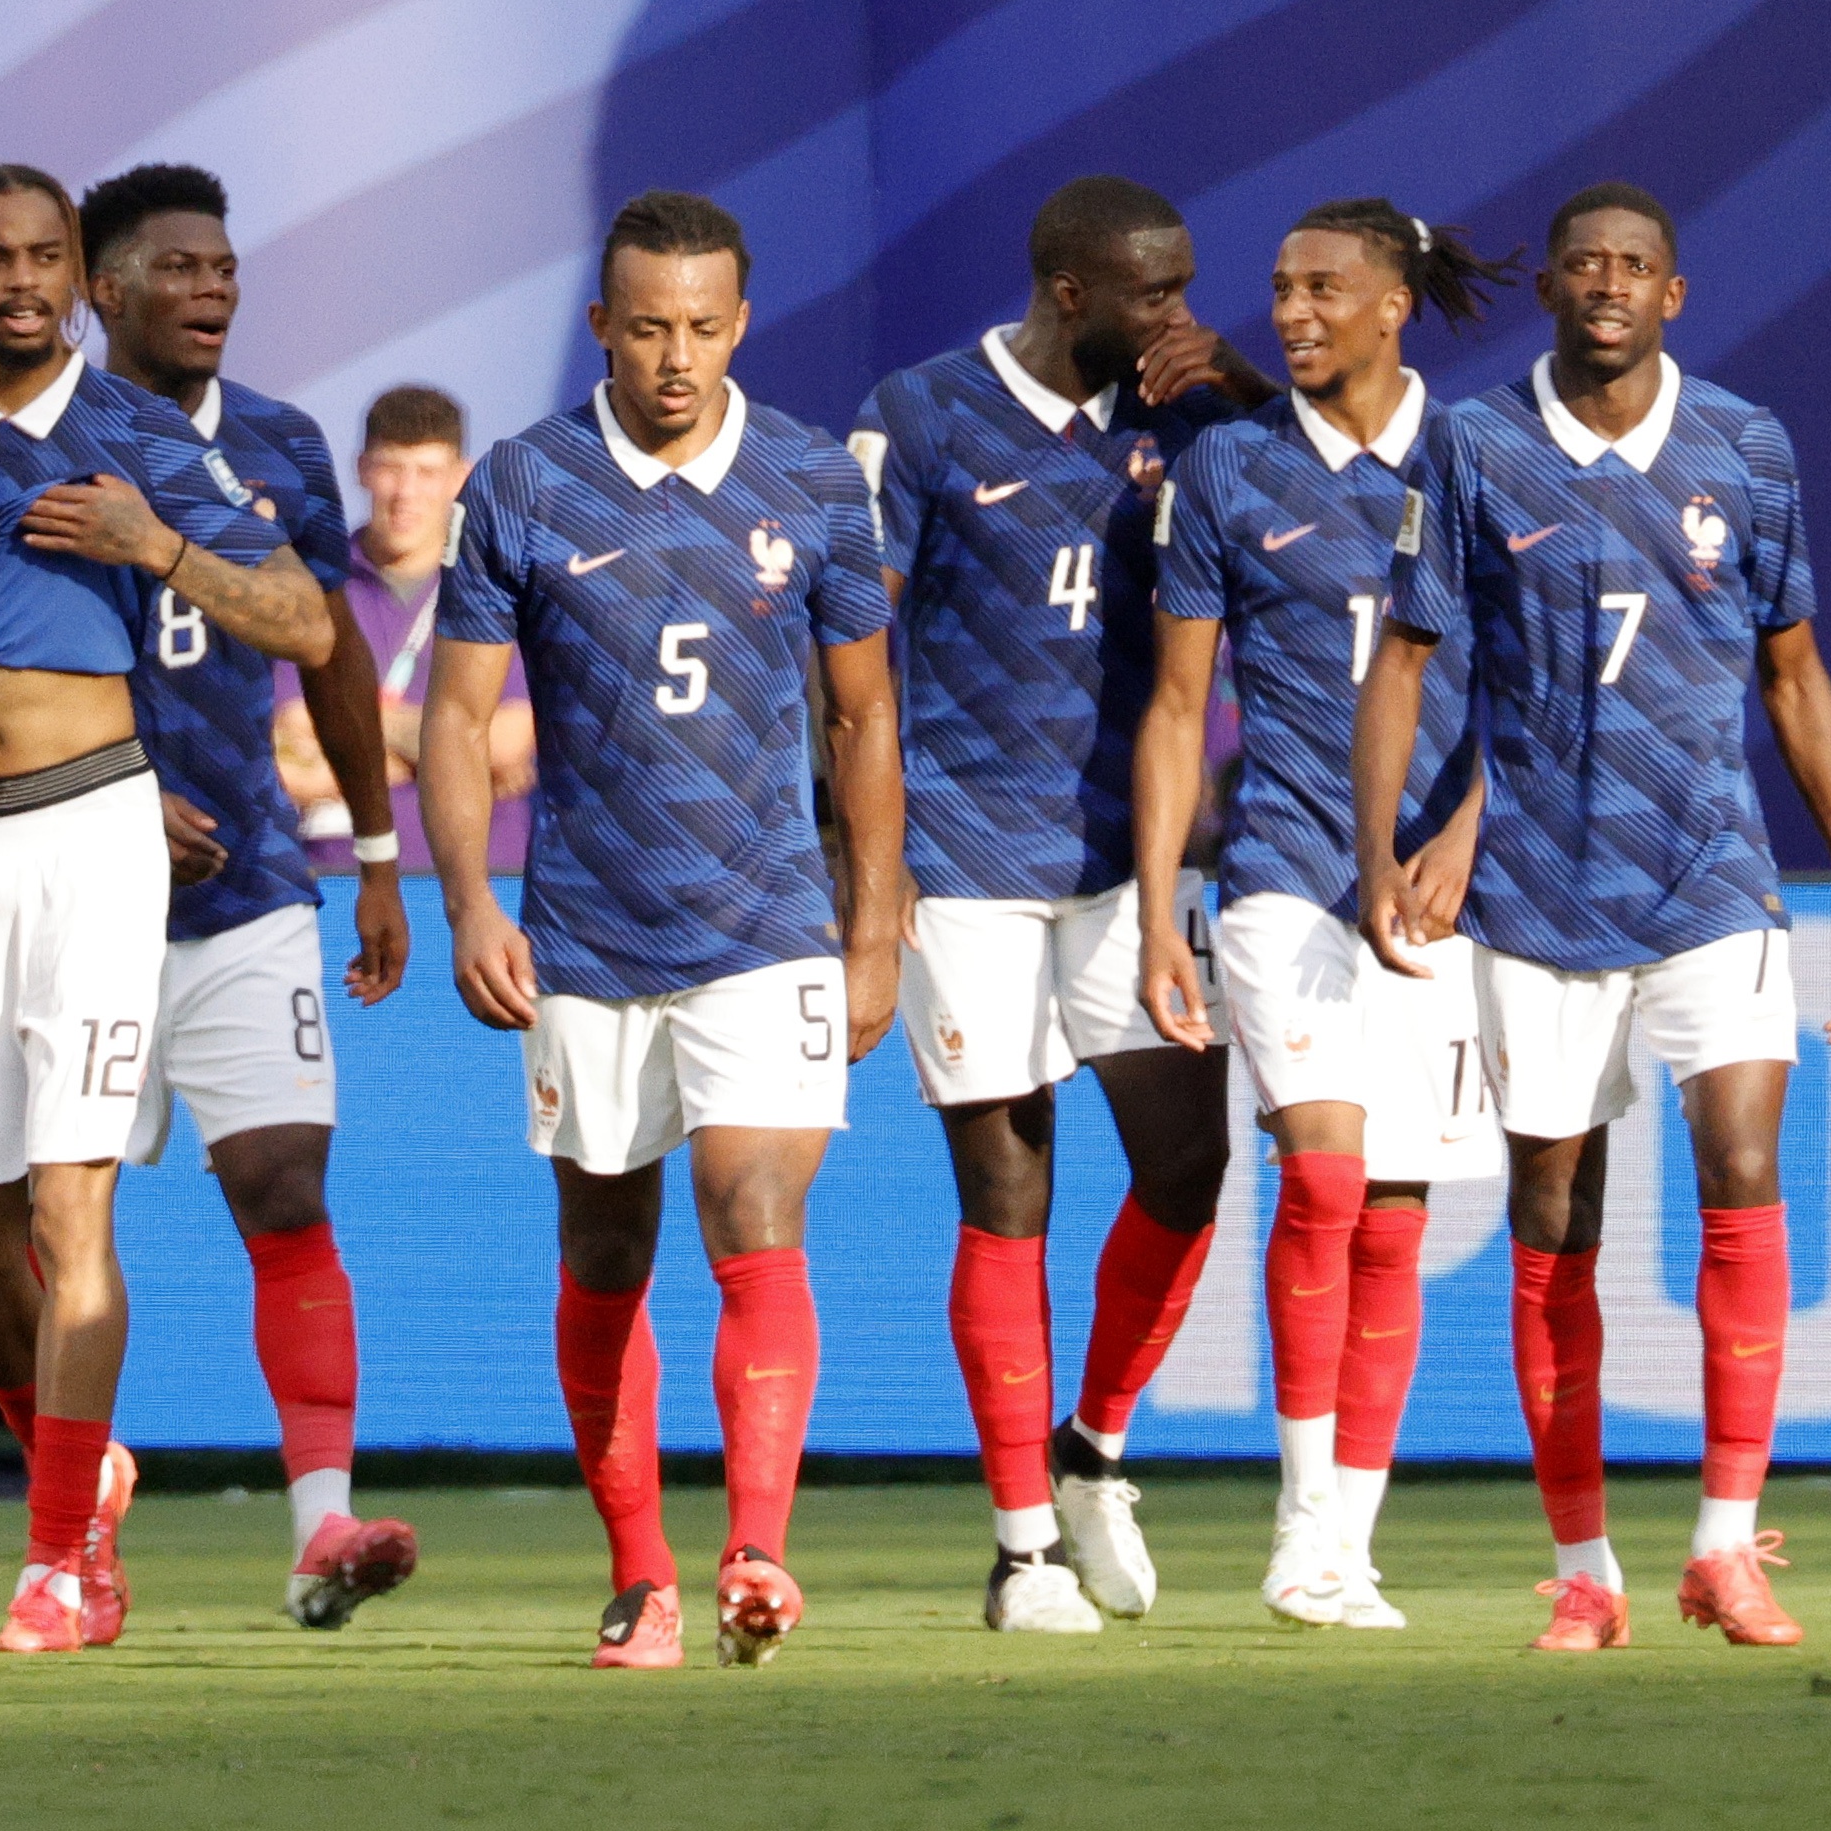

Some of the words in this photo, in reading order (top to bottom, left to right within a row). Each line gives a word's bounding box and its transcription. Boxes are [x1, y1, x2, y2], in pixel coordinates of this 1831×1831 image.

[158, 587, 207, 670] 8
[1048, 543, 1097, 632] 4
[654, 620, 710, 716] 5
[1599, 592, 1648, 686] 7
[80, 1018, 142, 1098] 12
[291, 986, 325, 1063] 8
[797, 983, 833, 1062] 5
